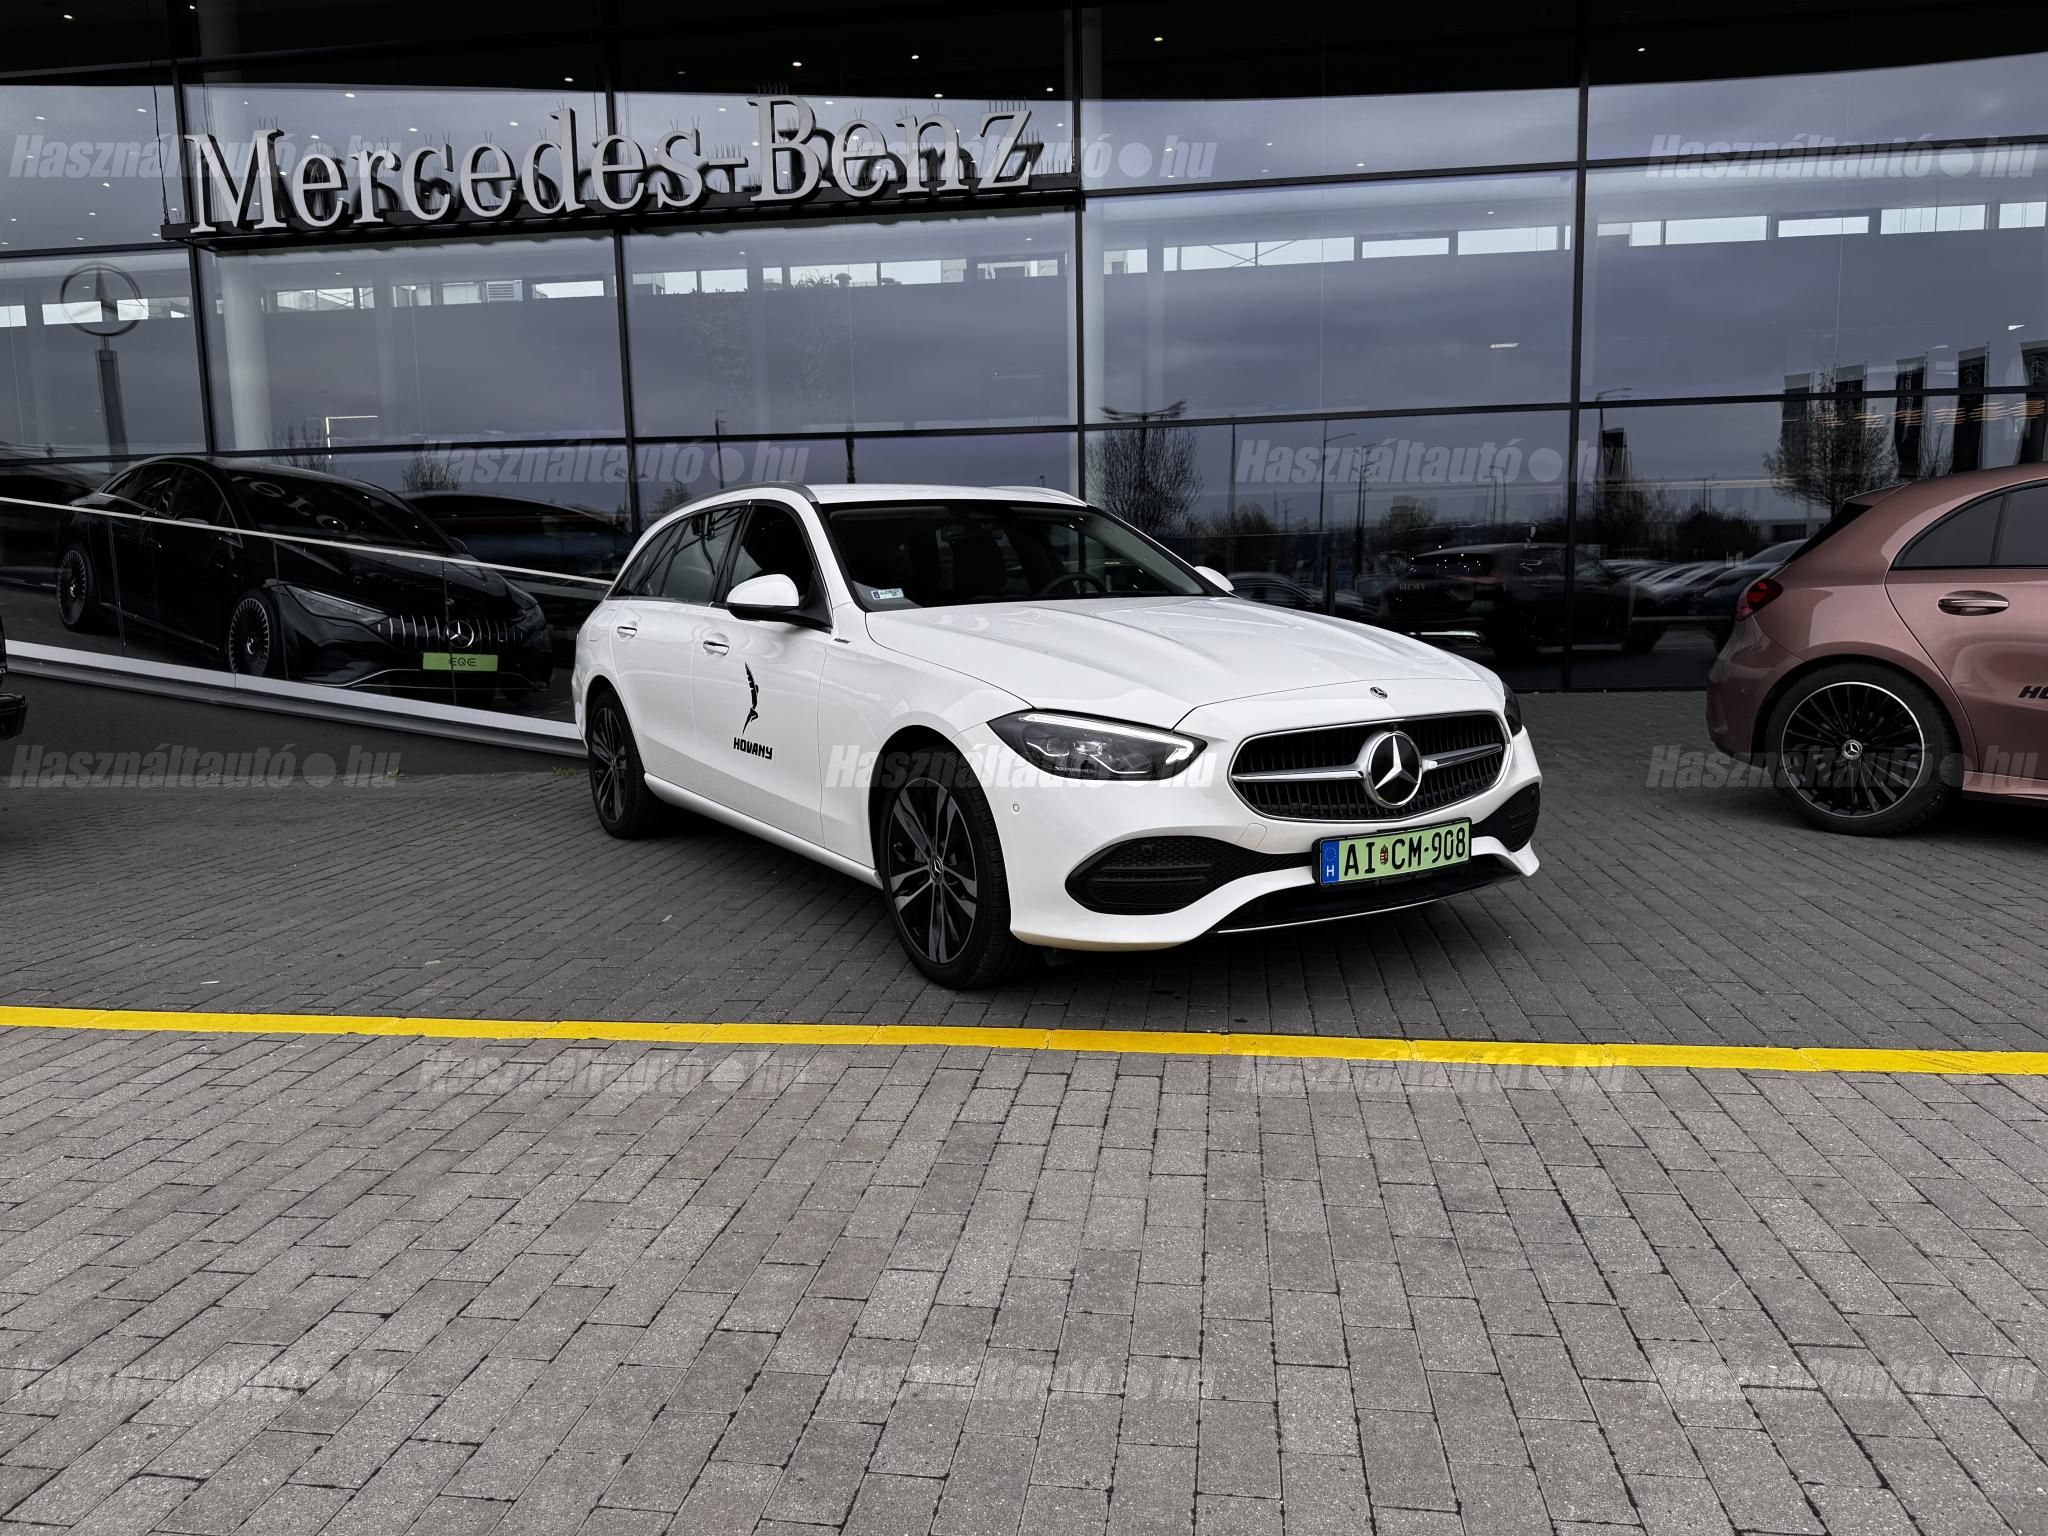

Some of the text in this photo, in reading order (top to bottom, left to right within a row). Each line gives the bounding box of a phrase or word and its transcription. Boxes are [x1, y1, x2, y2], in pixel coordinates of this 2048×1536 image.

[186, 94, 1033, 234] Mercedes-Benz
[448, 657, 478, 667] EQE
[732, 736, 773, 760] HOVANY
[1343, 826, 1466, 876] AI CM-908
[1326, 865, 1335, 877] H
